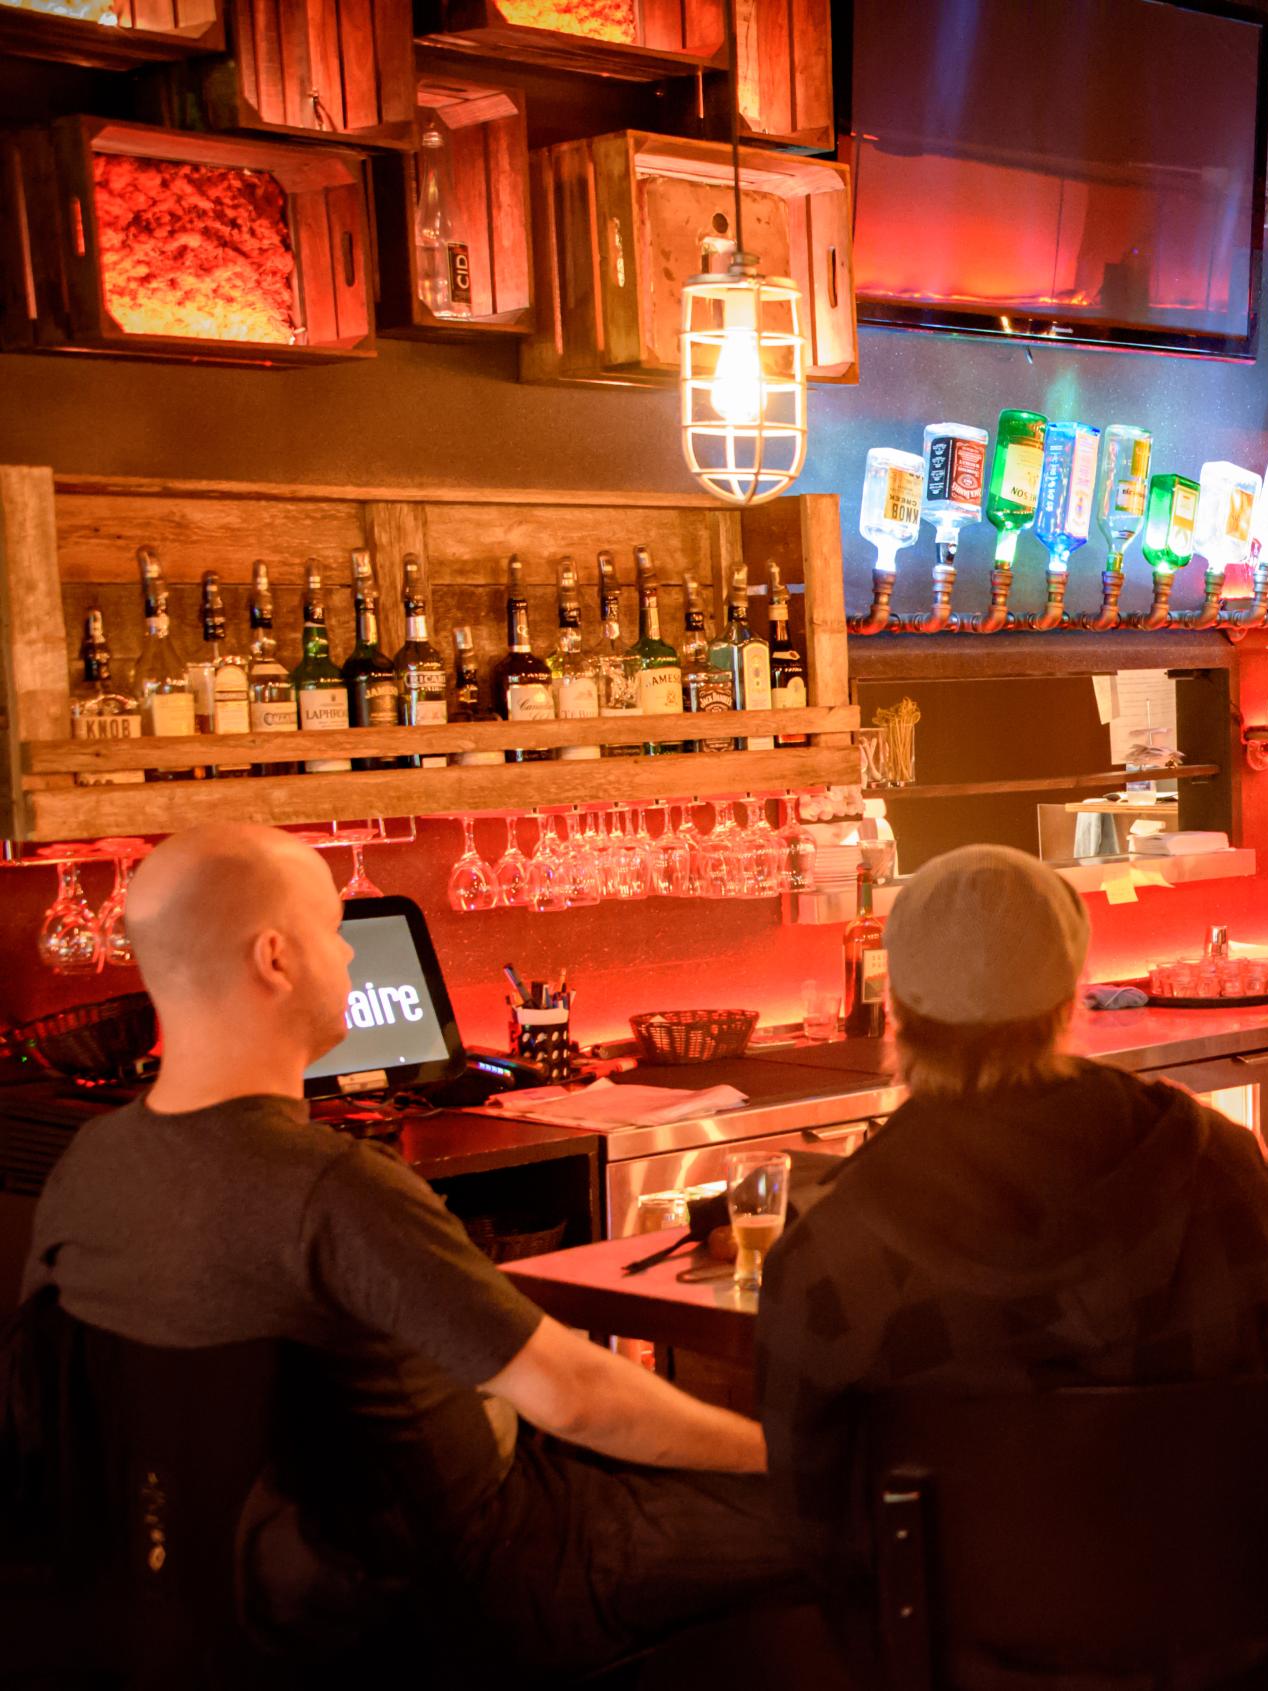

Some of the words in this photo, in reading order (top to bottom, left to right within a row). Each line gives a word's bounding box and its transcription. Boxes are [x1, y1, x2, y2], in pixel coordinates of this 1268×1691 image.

[456, 255, 469, 289] CID
[891, 503, 919, 524] KNOB
[86, 719, 131, 738] KNOB
